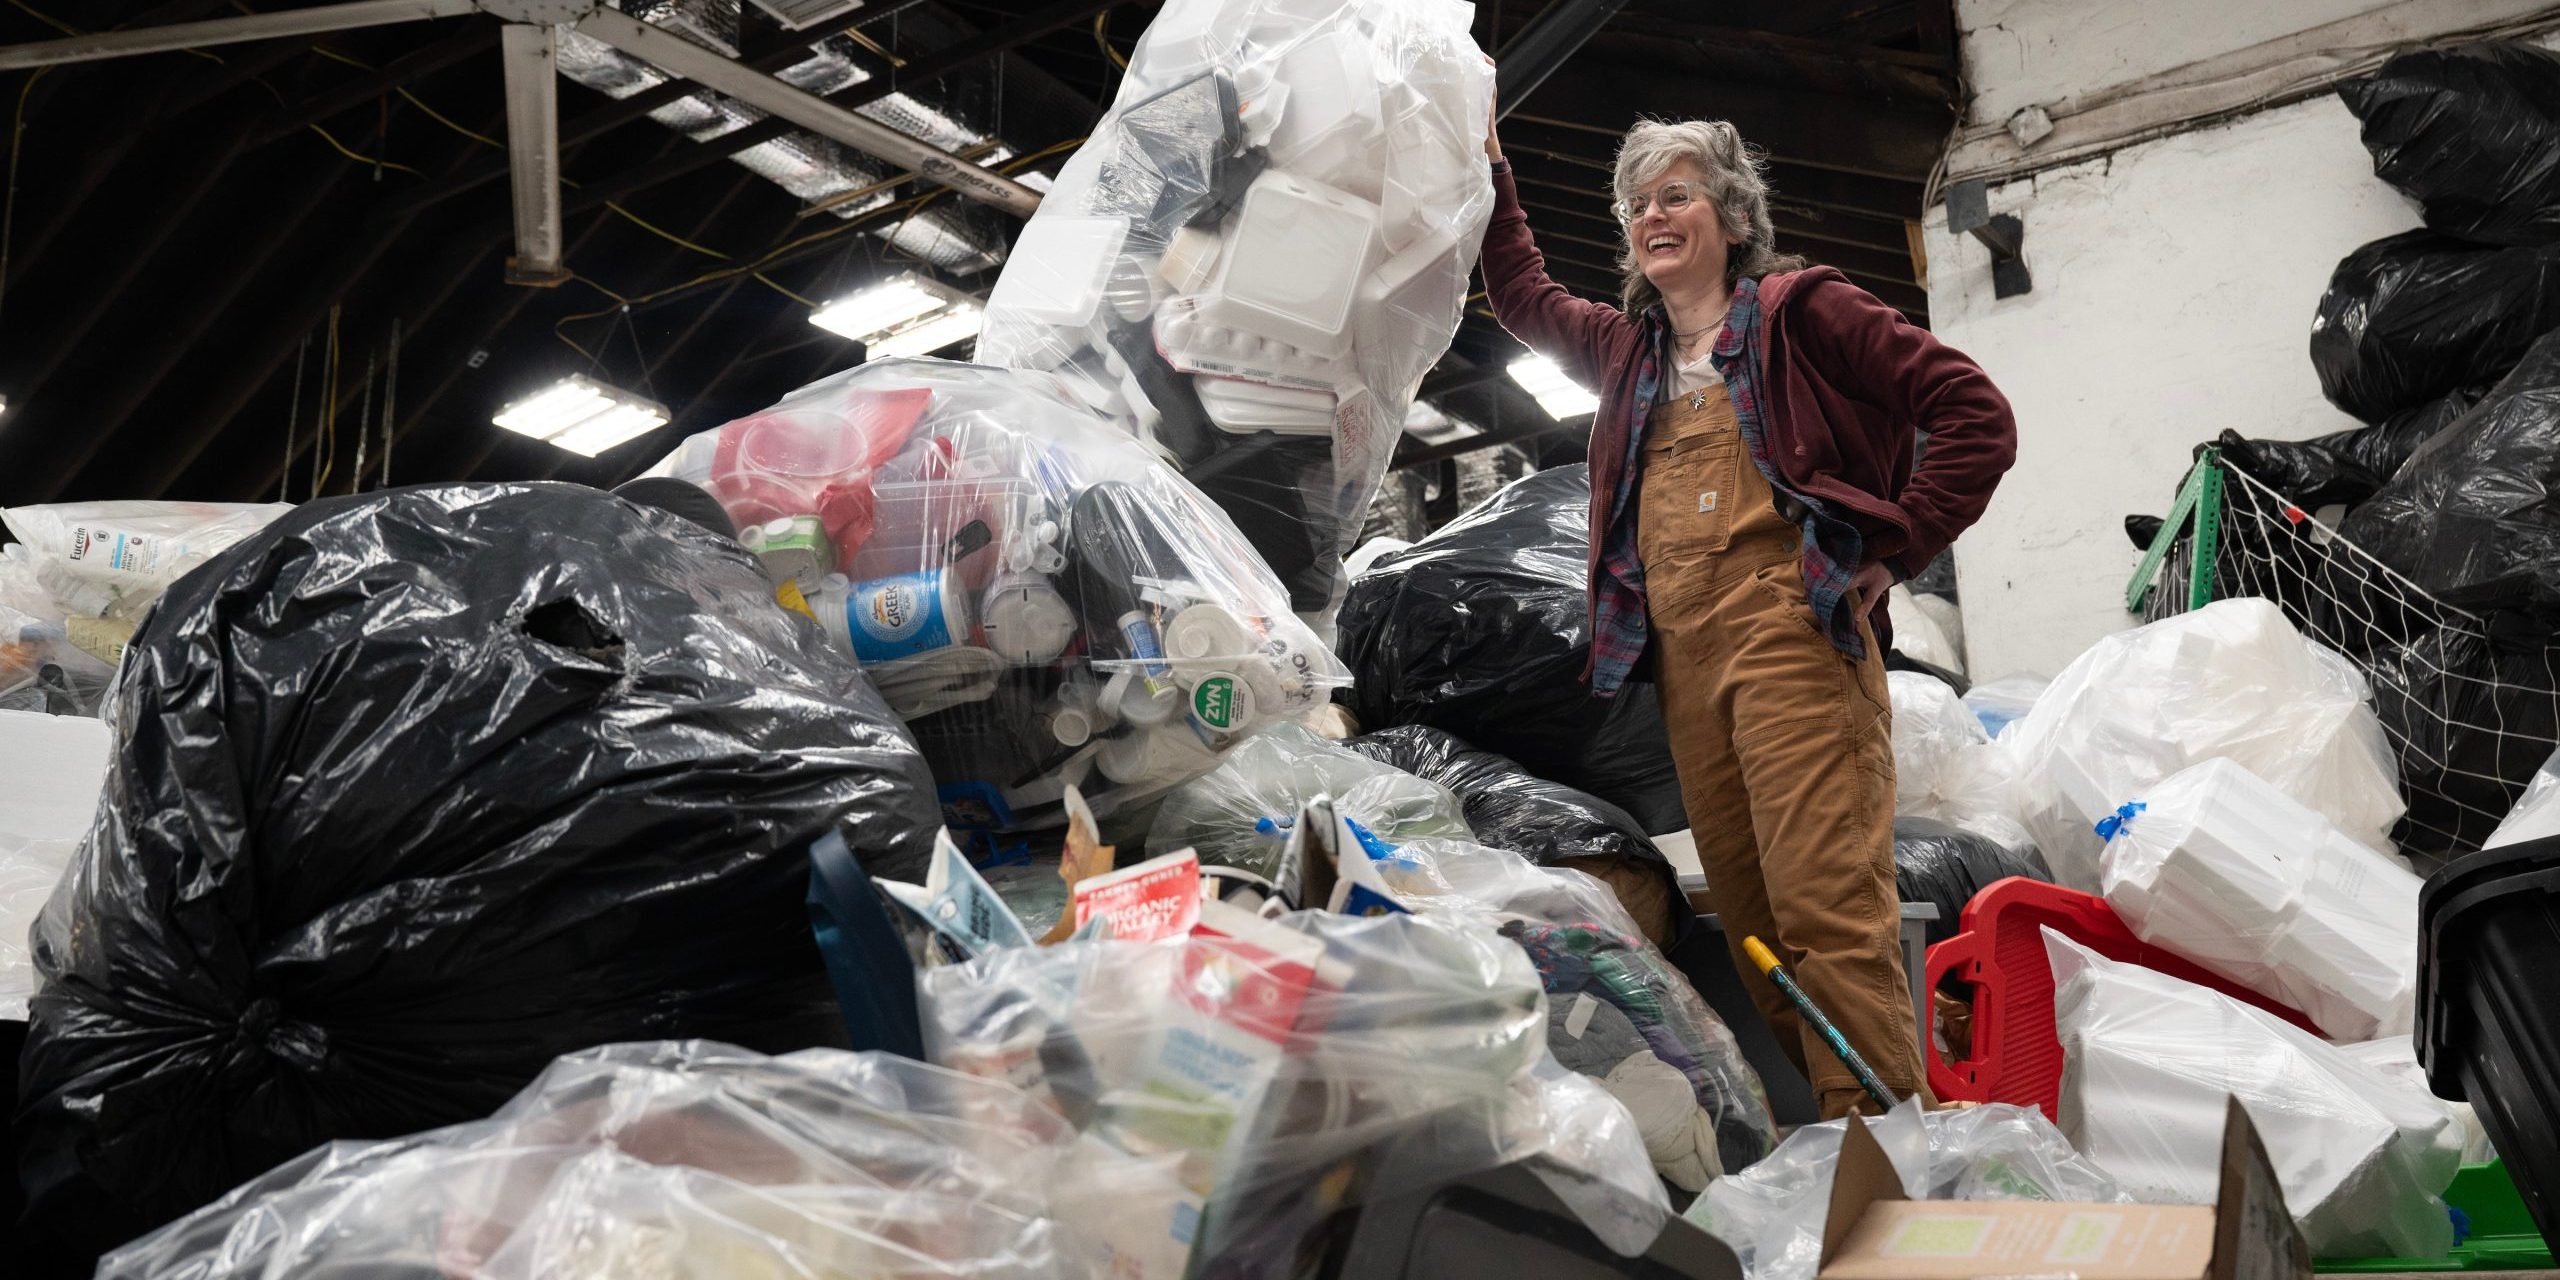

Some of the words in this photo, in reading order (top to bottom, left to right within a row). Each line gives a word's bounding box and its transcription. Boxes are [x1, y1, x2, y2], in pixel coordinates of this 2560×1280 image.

[70, 527, 86, 561] Eucerin
[885, 585, 901, 628] GREEK
[1206, 684, 1222, 720] ZYN
